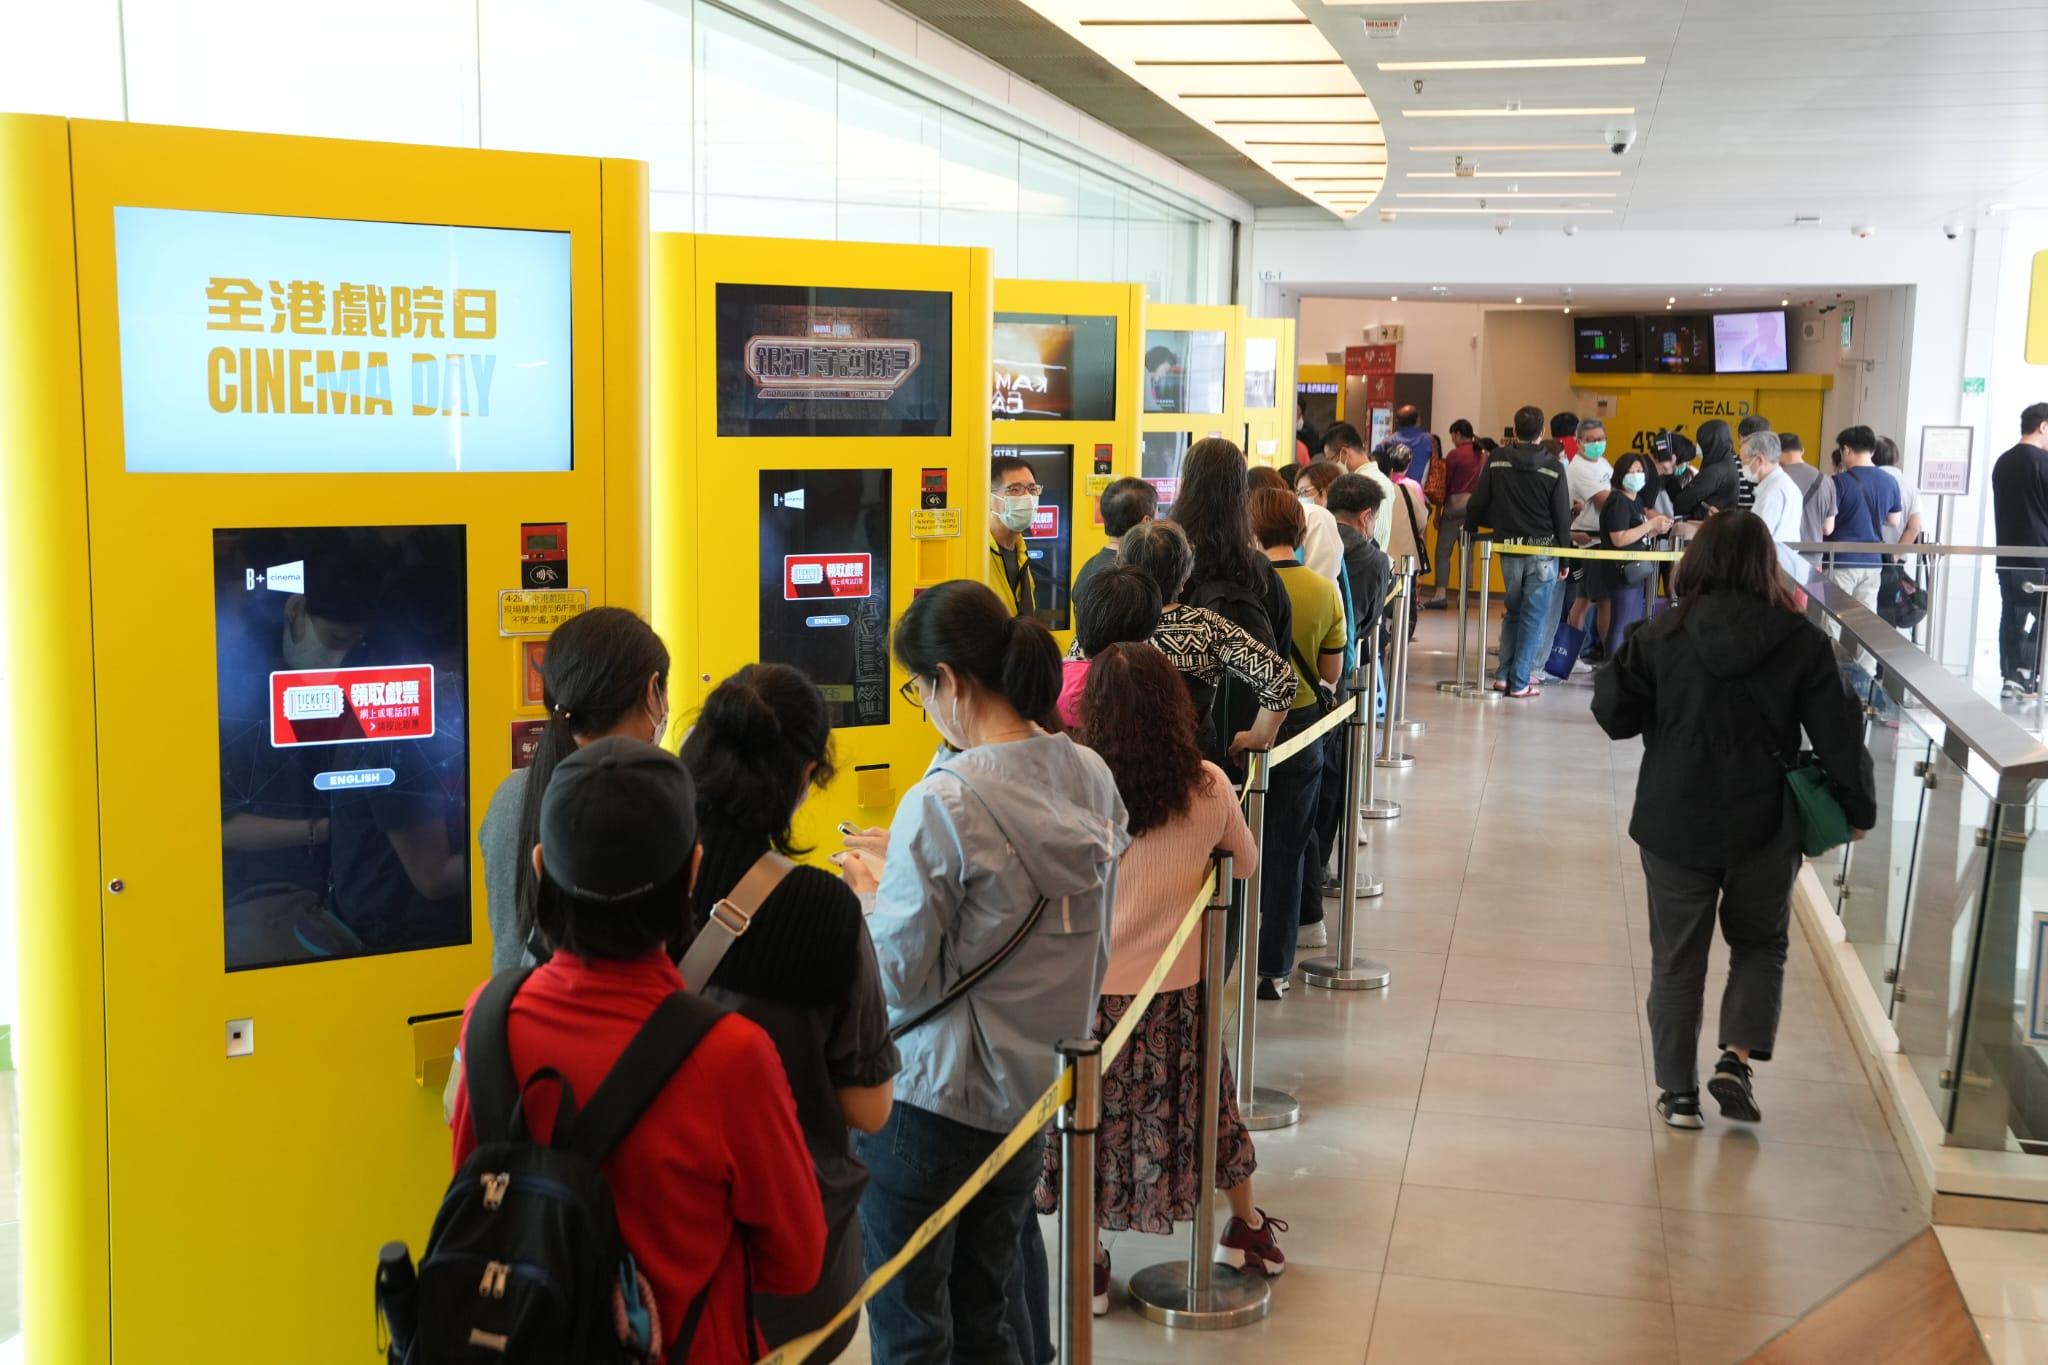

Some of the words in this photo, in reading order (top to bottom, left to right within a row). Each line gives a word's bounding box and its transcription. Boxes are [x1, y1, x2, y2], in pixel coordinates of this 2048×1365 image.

[205, 277, 497, 340] 全港戲院日
[207, 346, 393, 416] CINEMA
[411, 352, 497, 417] DAY
[1692, 400, 1735, 416] REAL
[1632, 424, 1686, 453] 4D
[270, 574, 301, 582] cinema
[297, 692, 331, 705] TICKETS
[329, 773, 380, 786] ENGLISH
